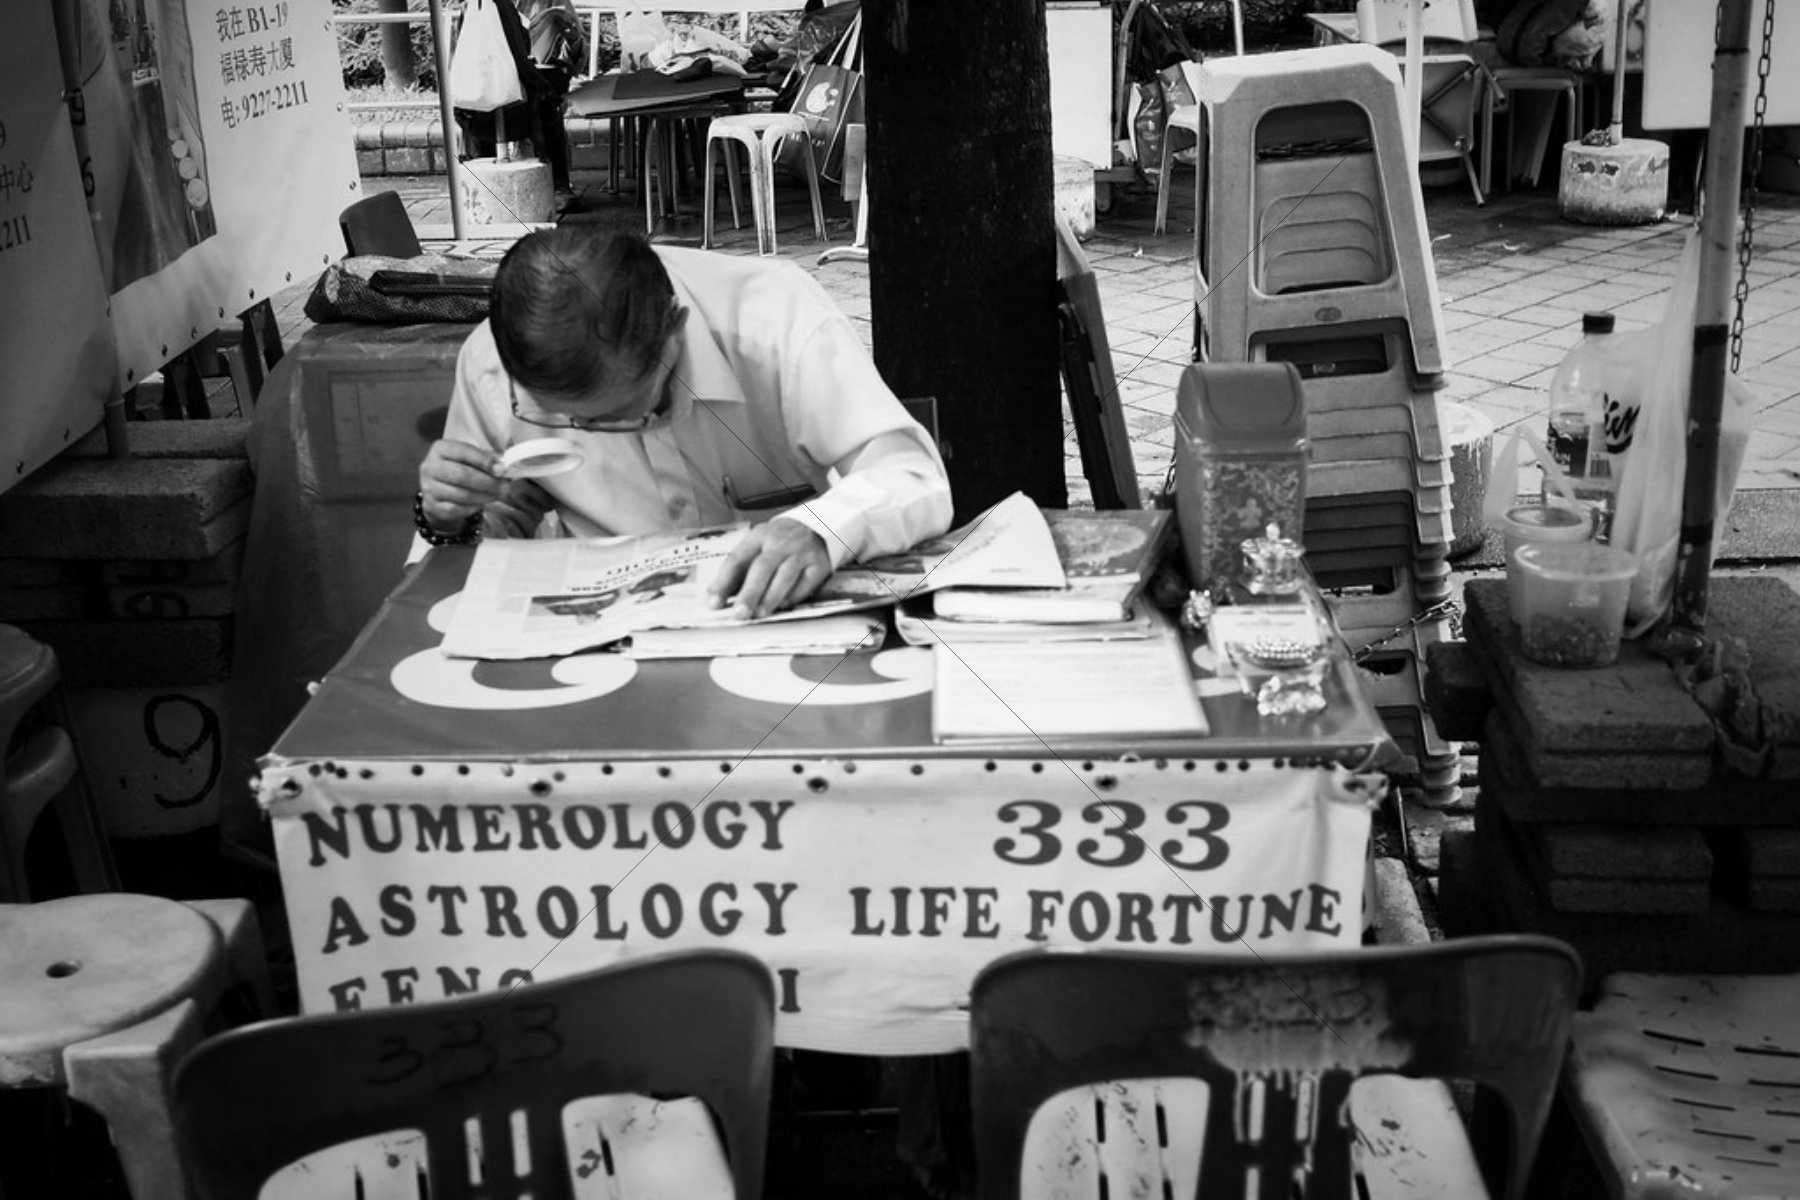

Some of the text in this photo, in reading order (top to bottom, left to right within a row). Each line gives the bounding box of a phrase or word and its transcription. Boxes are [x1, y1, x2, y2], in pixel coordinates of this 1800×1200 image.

[0, 213, 31, 252] 211
[301, 800, 796, 868] NUMEROLOGY
[993, 800, 1230, 871] 333
[321, 883, 798, 954] ASTROLOGY
[848, 883, 1343, 944] LIFE FORTUNE
